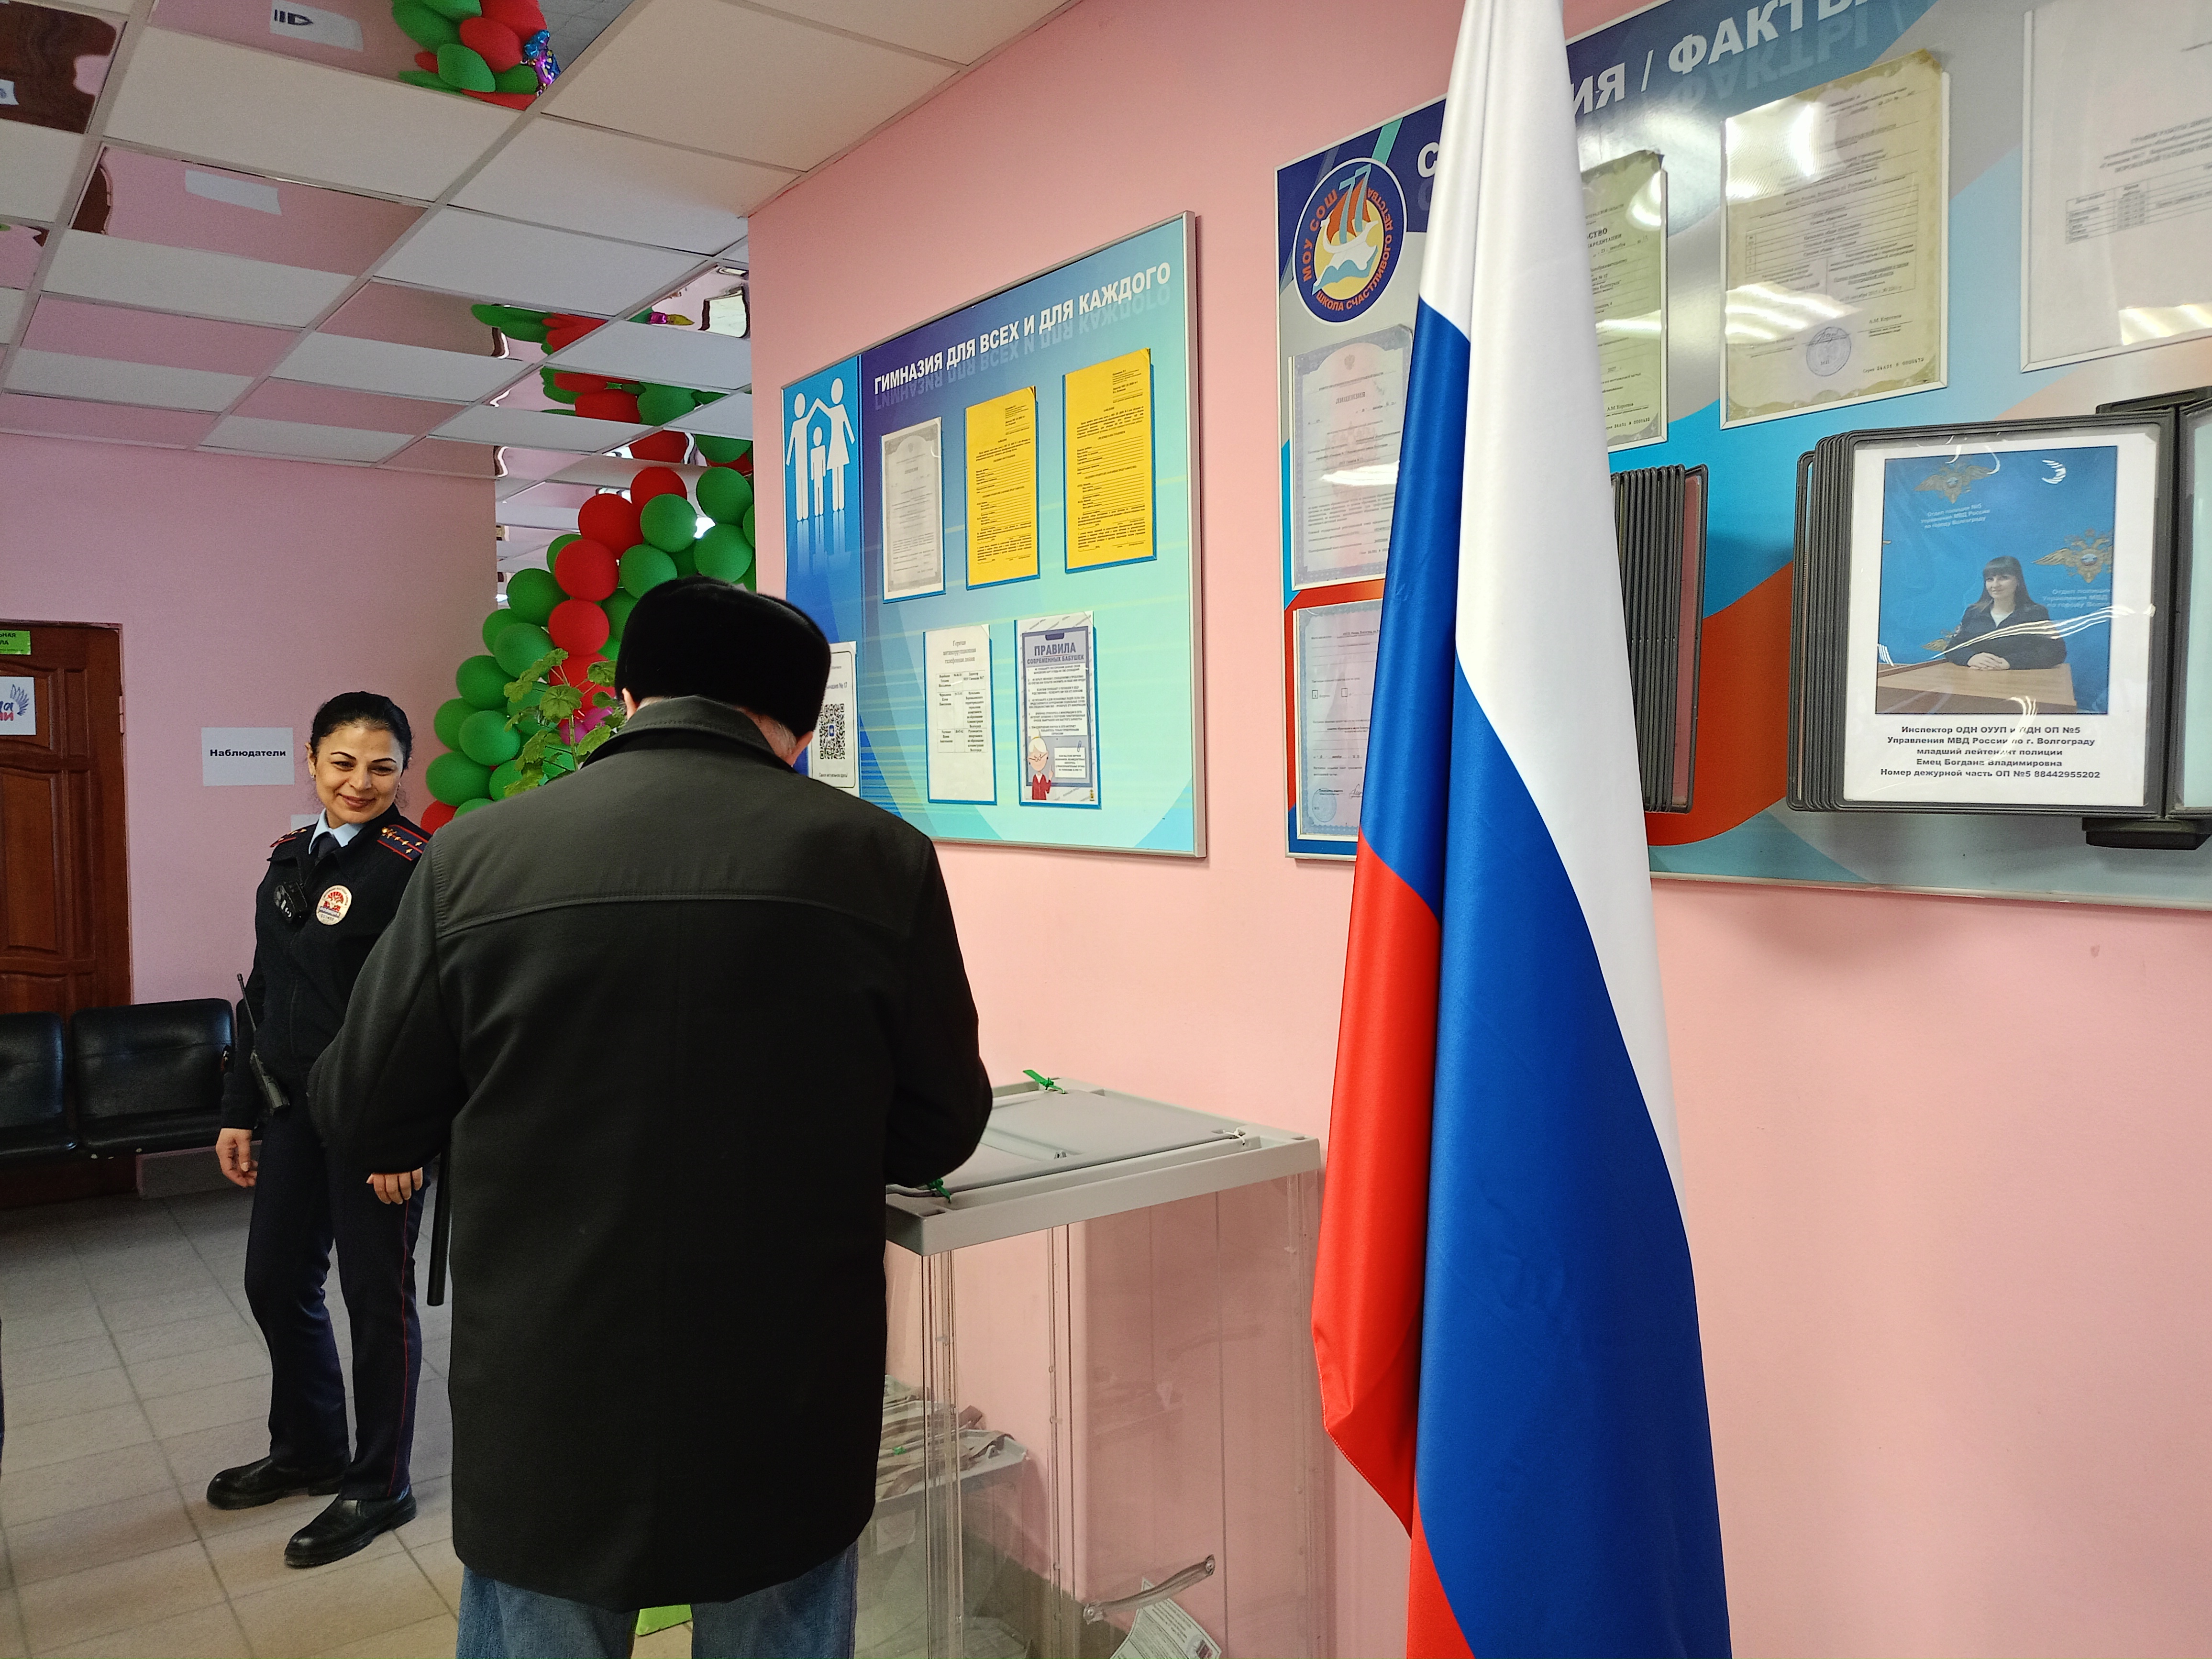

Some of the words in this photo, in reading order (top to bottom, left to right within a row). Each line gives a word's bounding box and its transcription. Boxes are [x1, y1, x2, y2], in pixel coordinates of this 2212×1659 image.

[1367, 188, 1394, 231] ДЕТСТВА
[1303, 238, 1313, 282] МОУ
[1310, 189, 1338, 231] СОШ
[1346, 234, 1393, 310] СЧАСТЛИВОГО
[1316, 291, 1344, 311] ШКОЛА
[874, 352, 943, 395] ГИМНАЗИЯ
[947, 338, 976, 370] ДЛЯ
[980, 321, 1019, 354] ВСЕХ
[1024, 315, 1035, 336] И
[1039, 299, 1073, 334] ДЛЯ
[1079, 262, 1171, 314] КАЖДОГО
[1034, 642, 1076, 656] ПРАВИЛА
[1902, 726, 1953, 734] Инспектор
[1887, 737, 1944, 745] Управления
[1947, 737, 1969, 745] МВД
[2037, 738, 2095, 747] Волгограду
[210, 749, 286, 757] Наблюдатели
[1917, 748, 1962, 756] младший
[1964, 748, 2016, 756] лейтеннт
[1916, 759, 1941, 767] Емец
[1945, 759, 1985, 767] Богдана
[1988, 759, 2062, 768] Владимировна
[1880, 769, 1912, 777] Номер
[1914, 769, 1962, 777] дежурной
